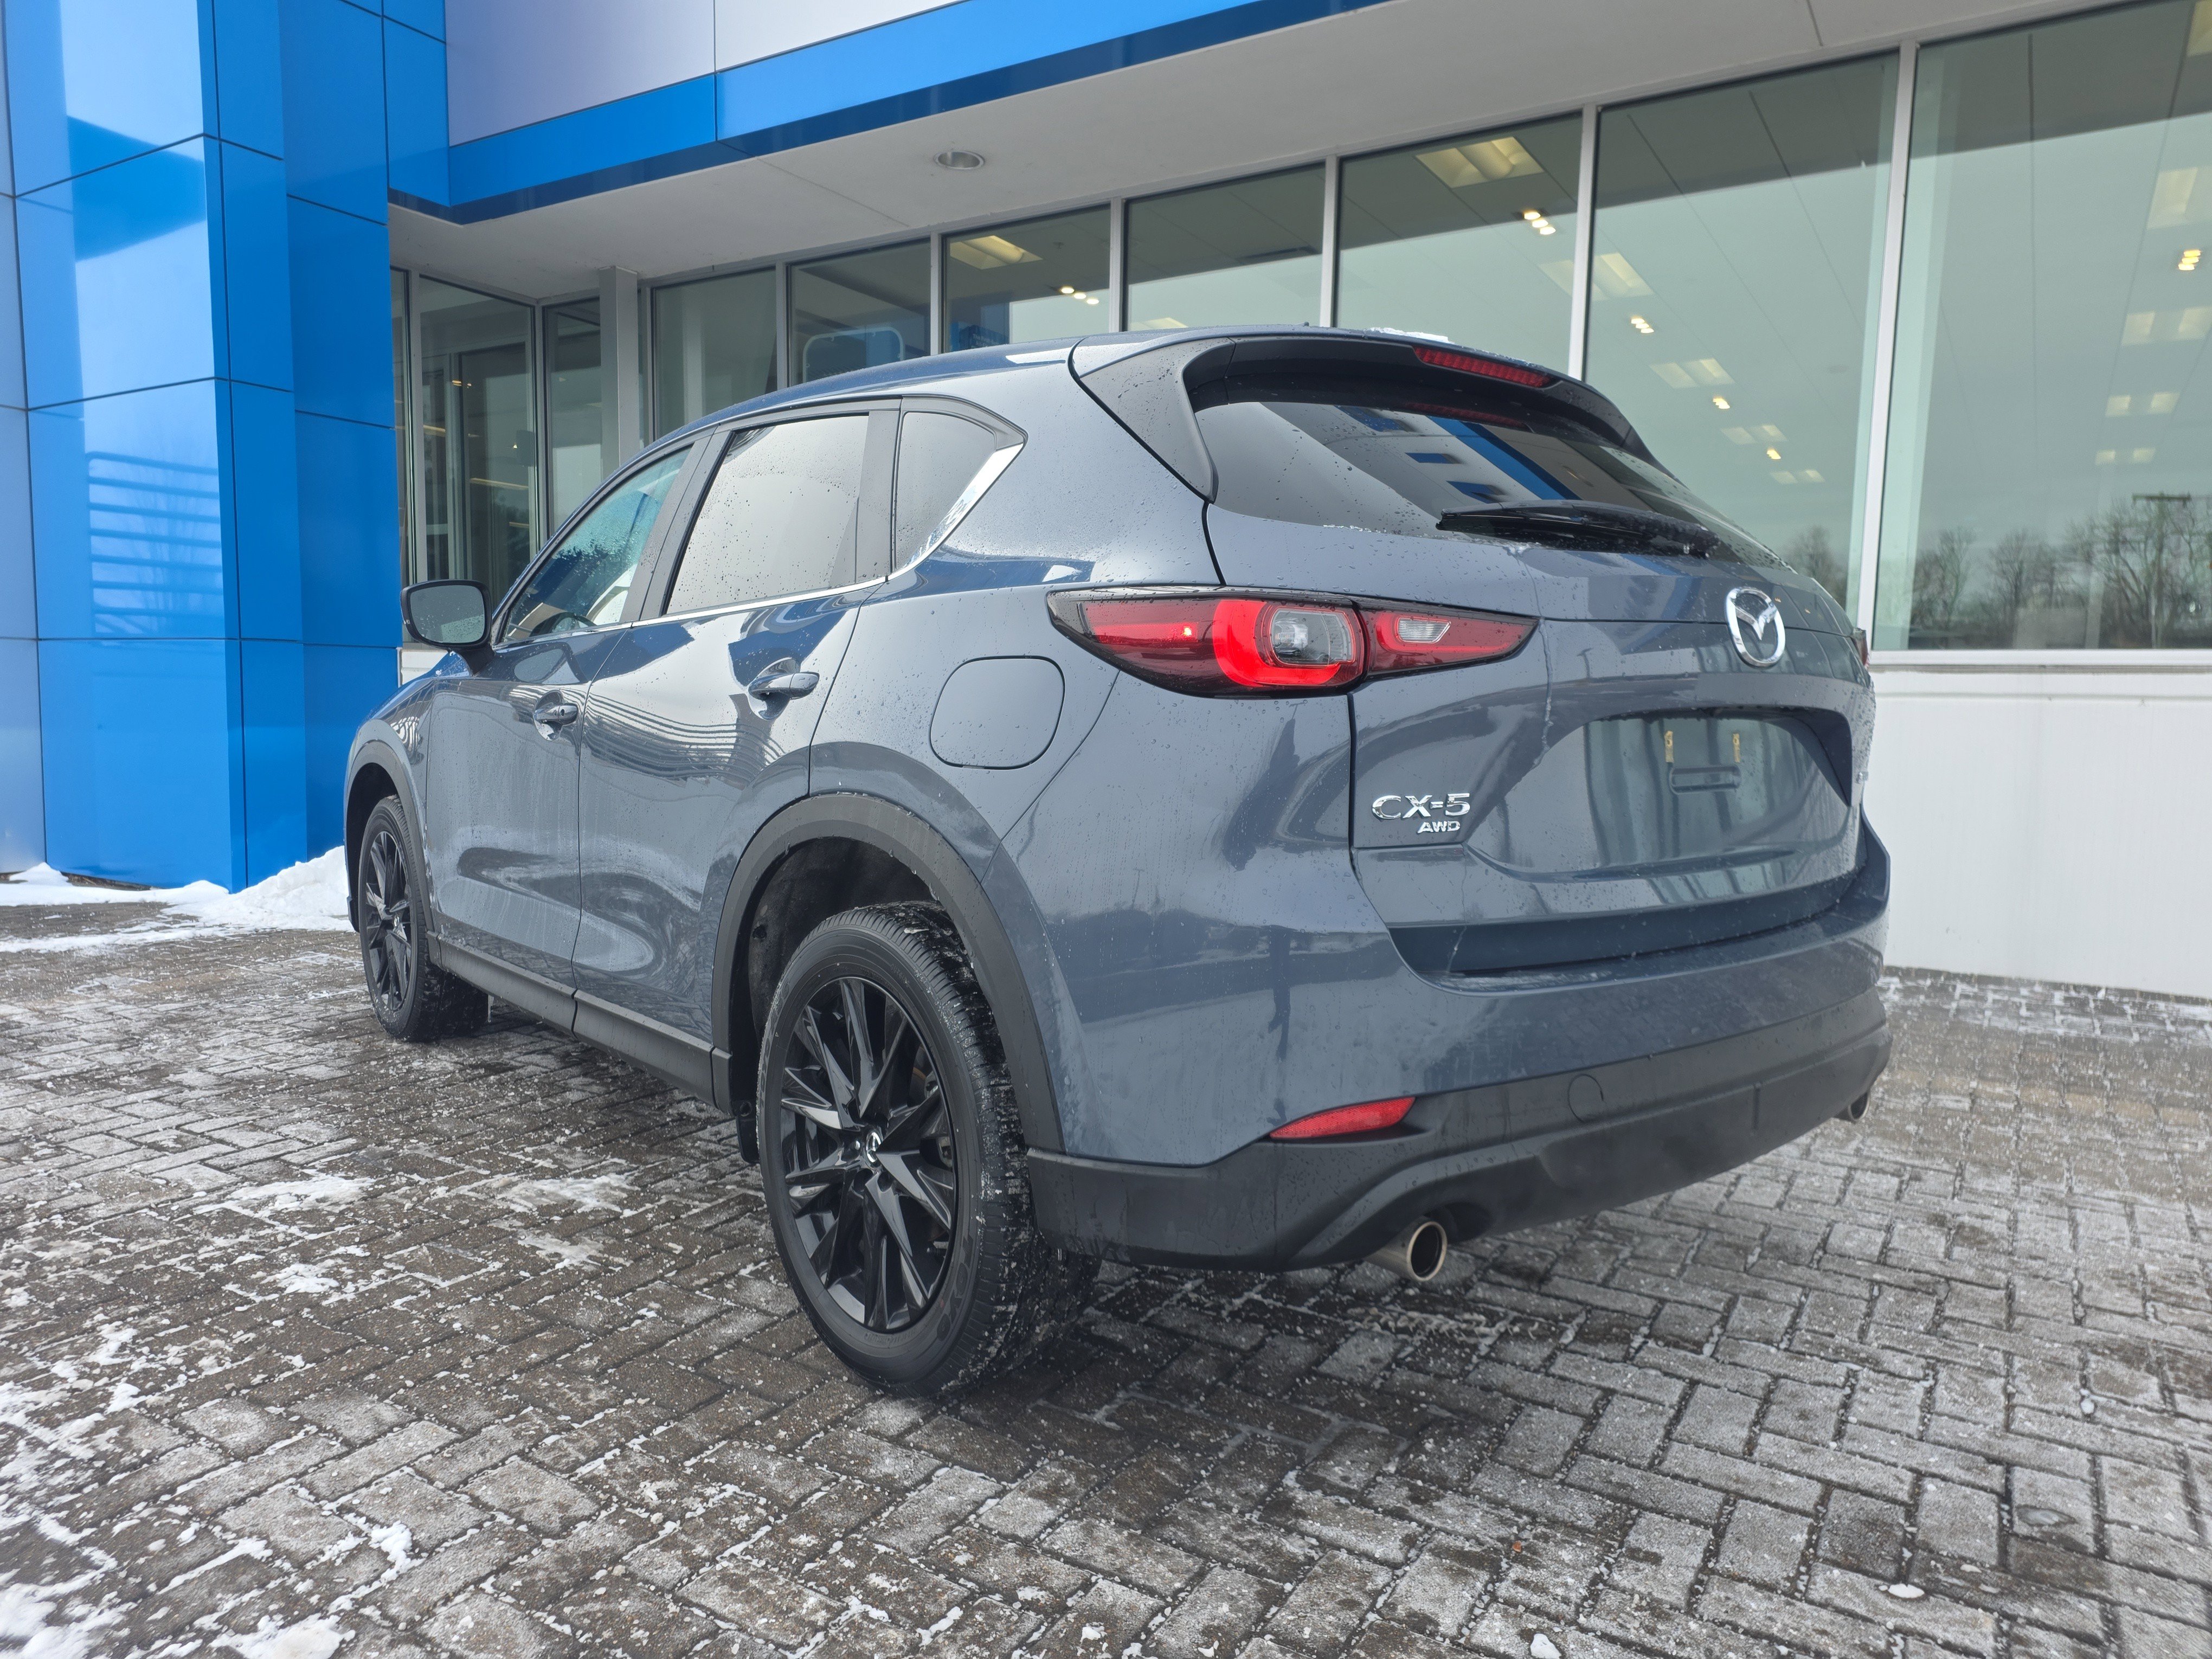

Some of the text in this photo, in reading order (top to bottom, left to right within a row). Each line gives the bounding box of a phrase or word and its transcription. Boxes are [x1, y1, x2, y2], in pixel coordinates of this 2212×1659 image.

[1372, 793, 1470, 819] CX-5
[1417, 821, 1461, 834] AWD
[937, 1235, 974, 1342] TOYO
